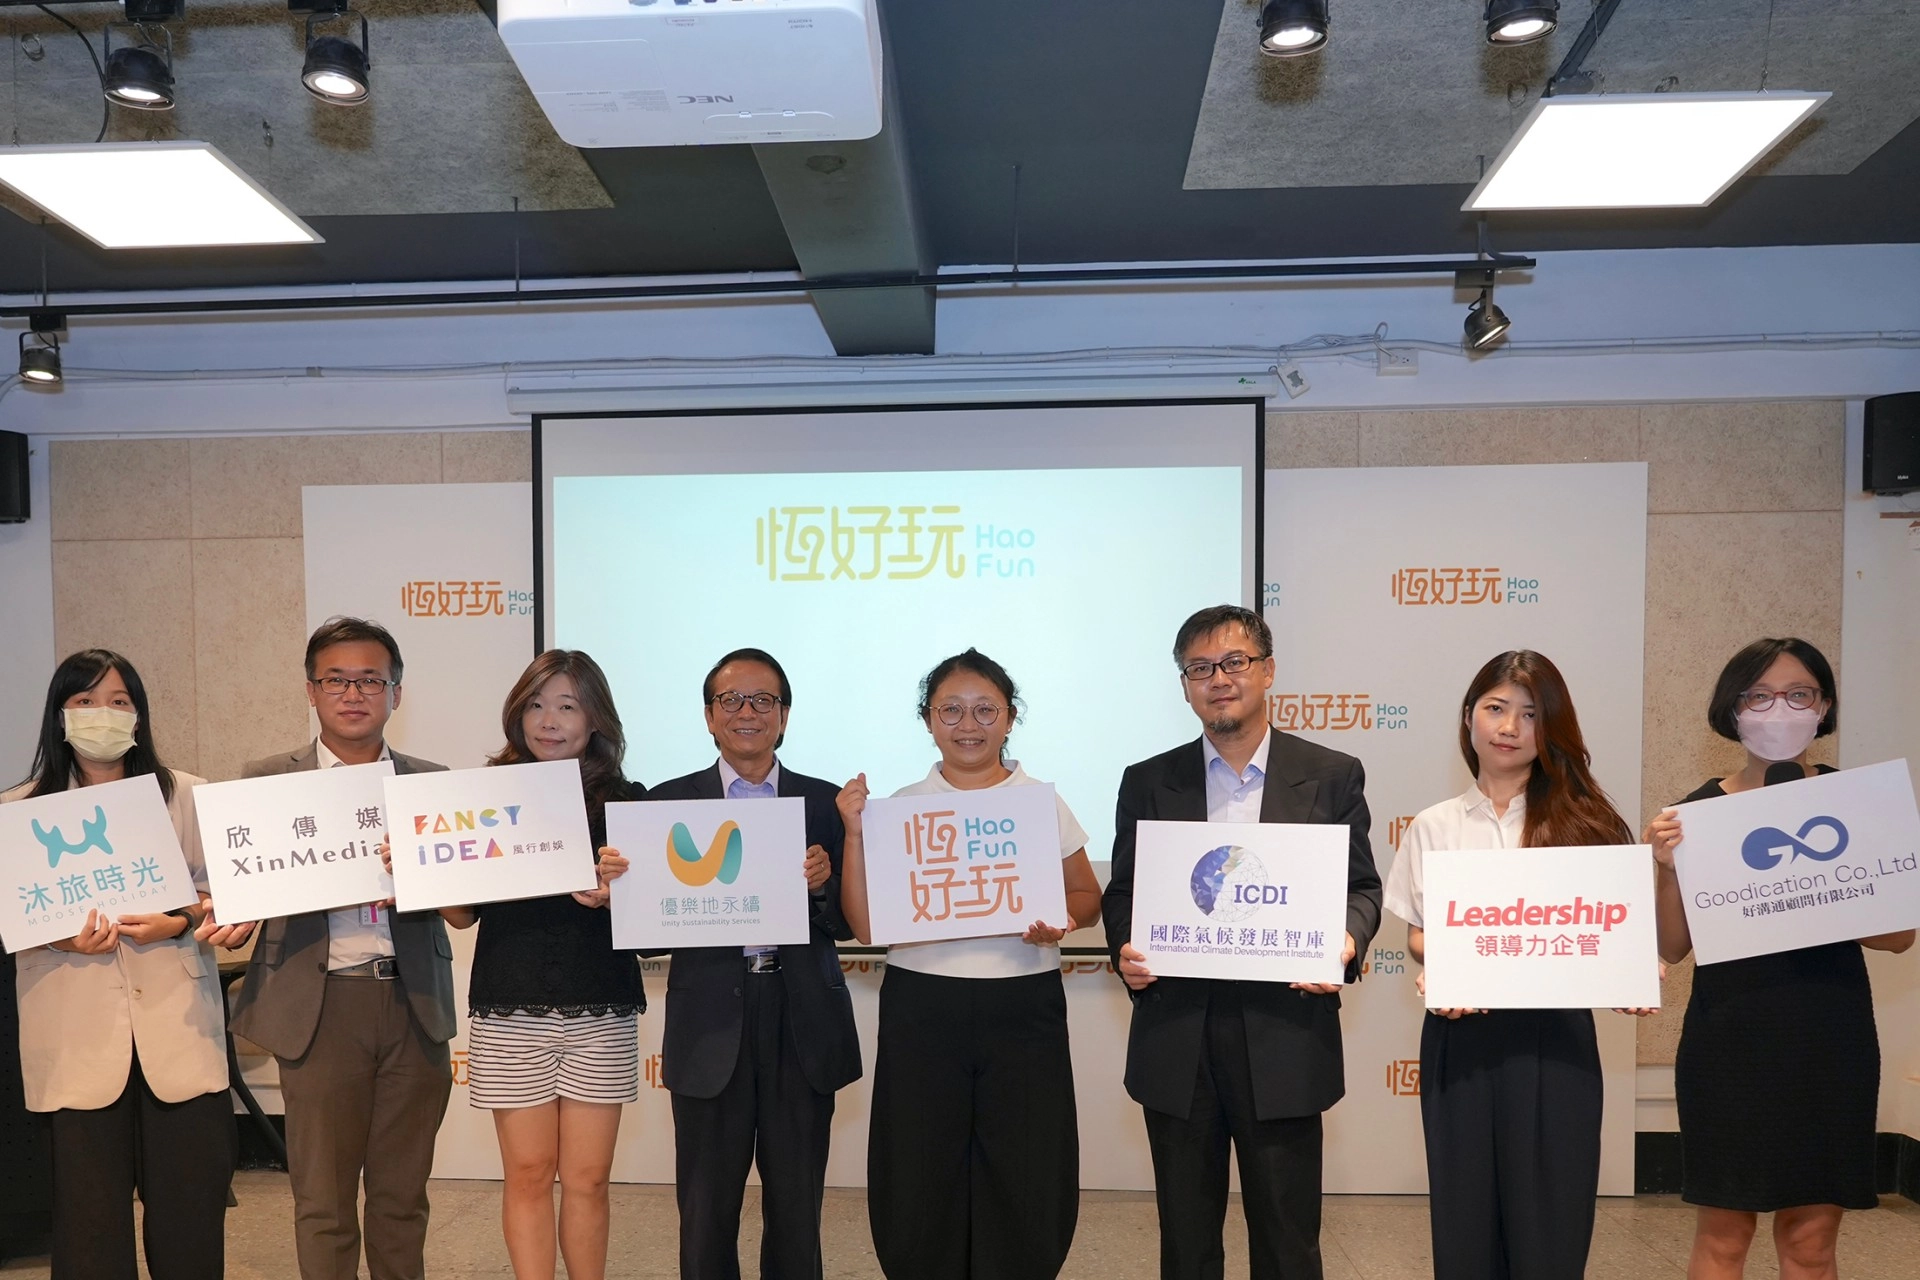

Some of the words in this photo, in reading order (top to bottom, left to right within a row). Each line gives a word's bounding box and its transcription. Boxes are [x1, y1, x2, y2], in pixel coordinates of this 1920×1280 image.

[677, 95, 734, 103] NEC
[756, 506, 966, 581] 恆好玩
[976, 524, 1035, 548] Hao
[976, 553, 1035, 578] Fun
[1263, 583, 1280, 593] ao
[1391, 568, 1502, 605] 恆好玩
[1507, 577, 1539, 589] Hao
[401, 582, 504, 616] 恆好玩
[1507, 591, 1538, 603] Fun
[1264, 694, 1372, 730] 恆好玩
[1376, 703, 1408, 715] Hao
[1376, 718, 1408, 729] Fun
[226, 806, 383, 849] 欣傳媒
[414, 805, 521, 835] FANCY
[965, 817, 1015, 837] Hao
[904, 810, 959, 865] 恆
[967, 840, 1017, 859] Fun
[18, 857, 164, 914] 沐旅時光
[910, 862, 1023, 923] 好玩
[1234, 884, 1288, 904] ICDI
[1695, 873, 1827, 909] Goodication
[28, 905, 86, 927] MOOSE
[97, 884, 168, 909] HOLIDAY
[660, 895, 760, 915] 優樂地永續
[1742, 883, 1875, 917] 好溝通顧問有限公司
[682, 918, 730, 927] Sustainability
[1446, 897, 1627, 931] Leadership
[1150, 924, 1324, 948] 國際氣候發展智庫
[1475, 934, 1600, 956] 領導力企管
[1150, 943, 1200, 953] International
[1201, 945, 1233, 955] Climate
[1234, 946, 1290, 958] Development
[1291, 950, 1324, 959] Institute
[1374, 949, 1405, 960] Hao
[1374, 963, 1405, 974] Fun
